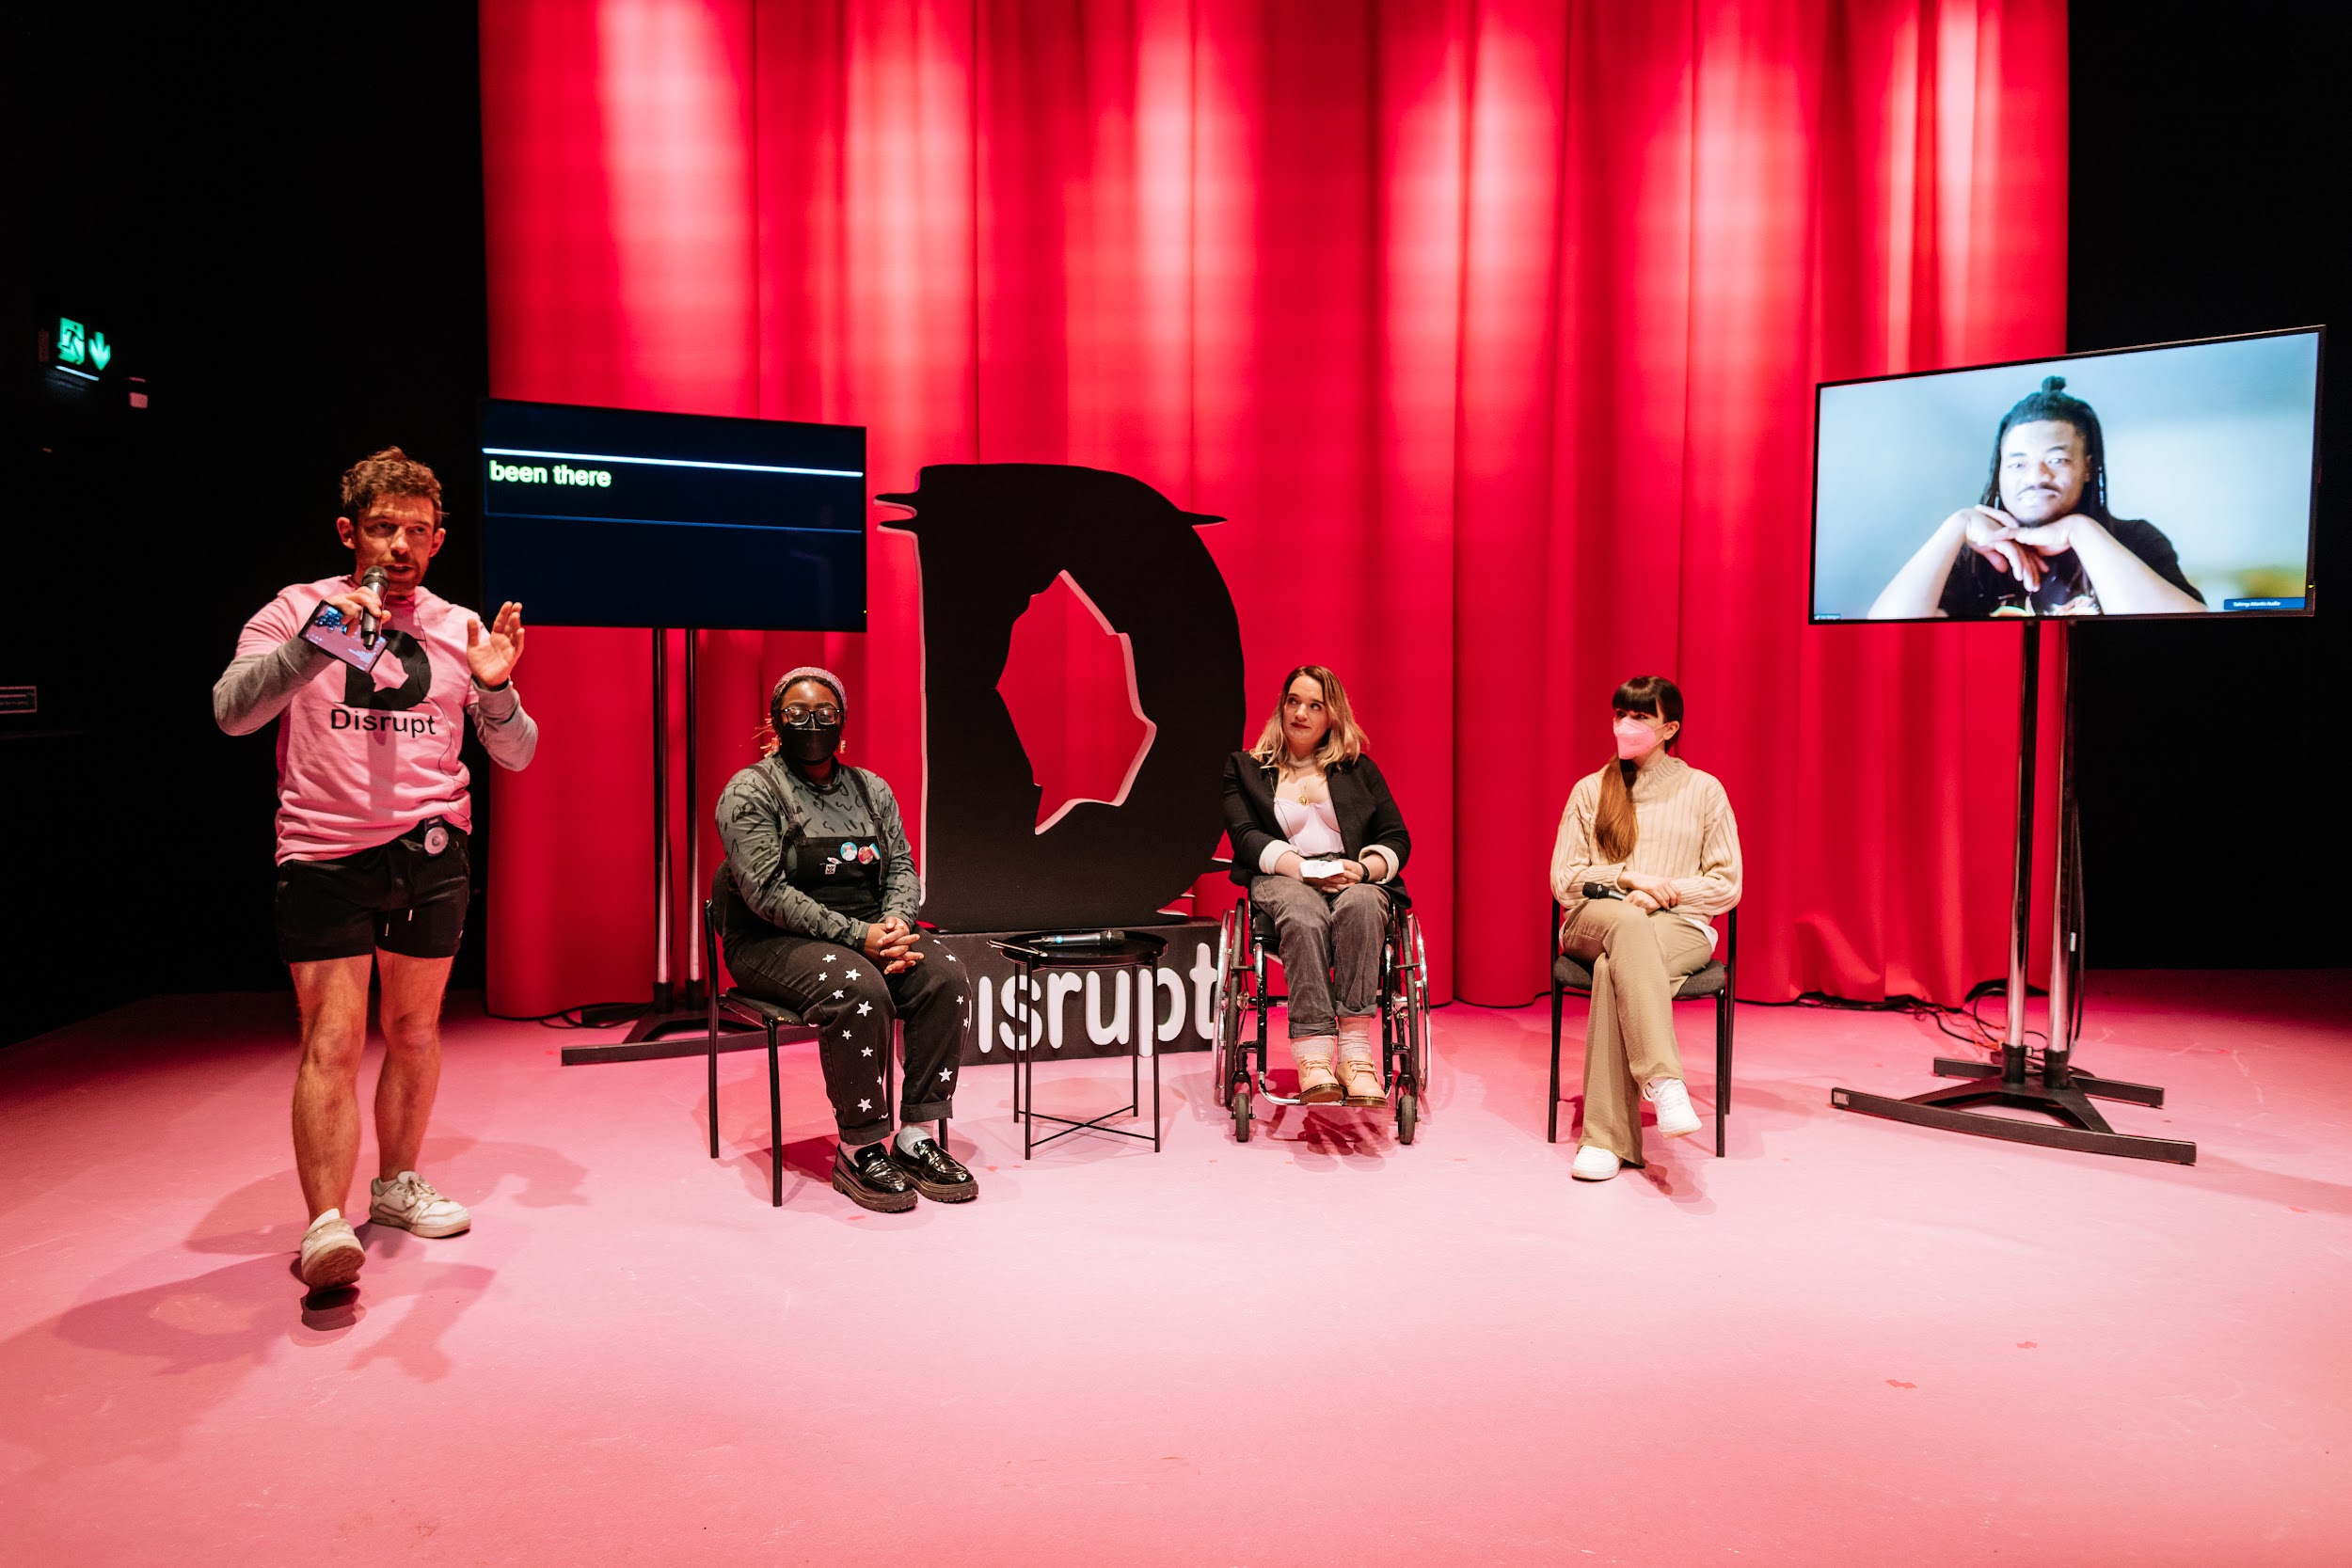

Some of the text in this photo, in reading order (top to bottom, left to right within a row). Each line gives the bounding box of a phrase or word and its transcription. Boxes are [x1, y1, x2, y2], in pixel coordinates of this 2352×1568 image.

[488, 459, 612, 488] been there
[330, 708, 437, 738] Disrupt
[968, 942, 1218, 1057] isrupt
